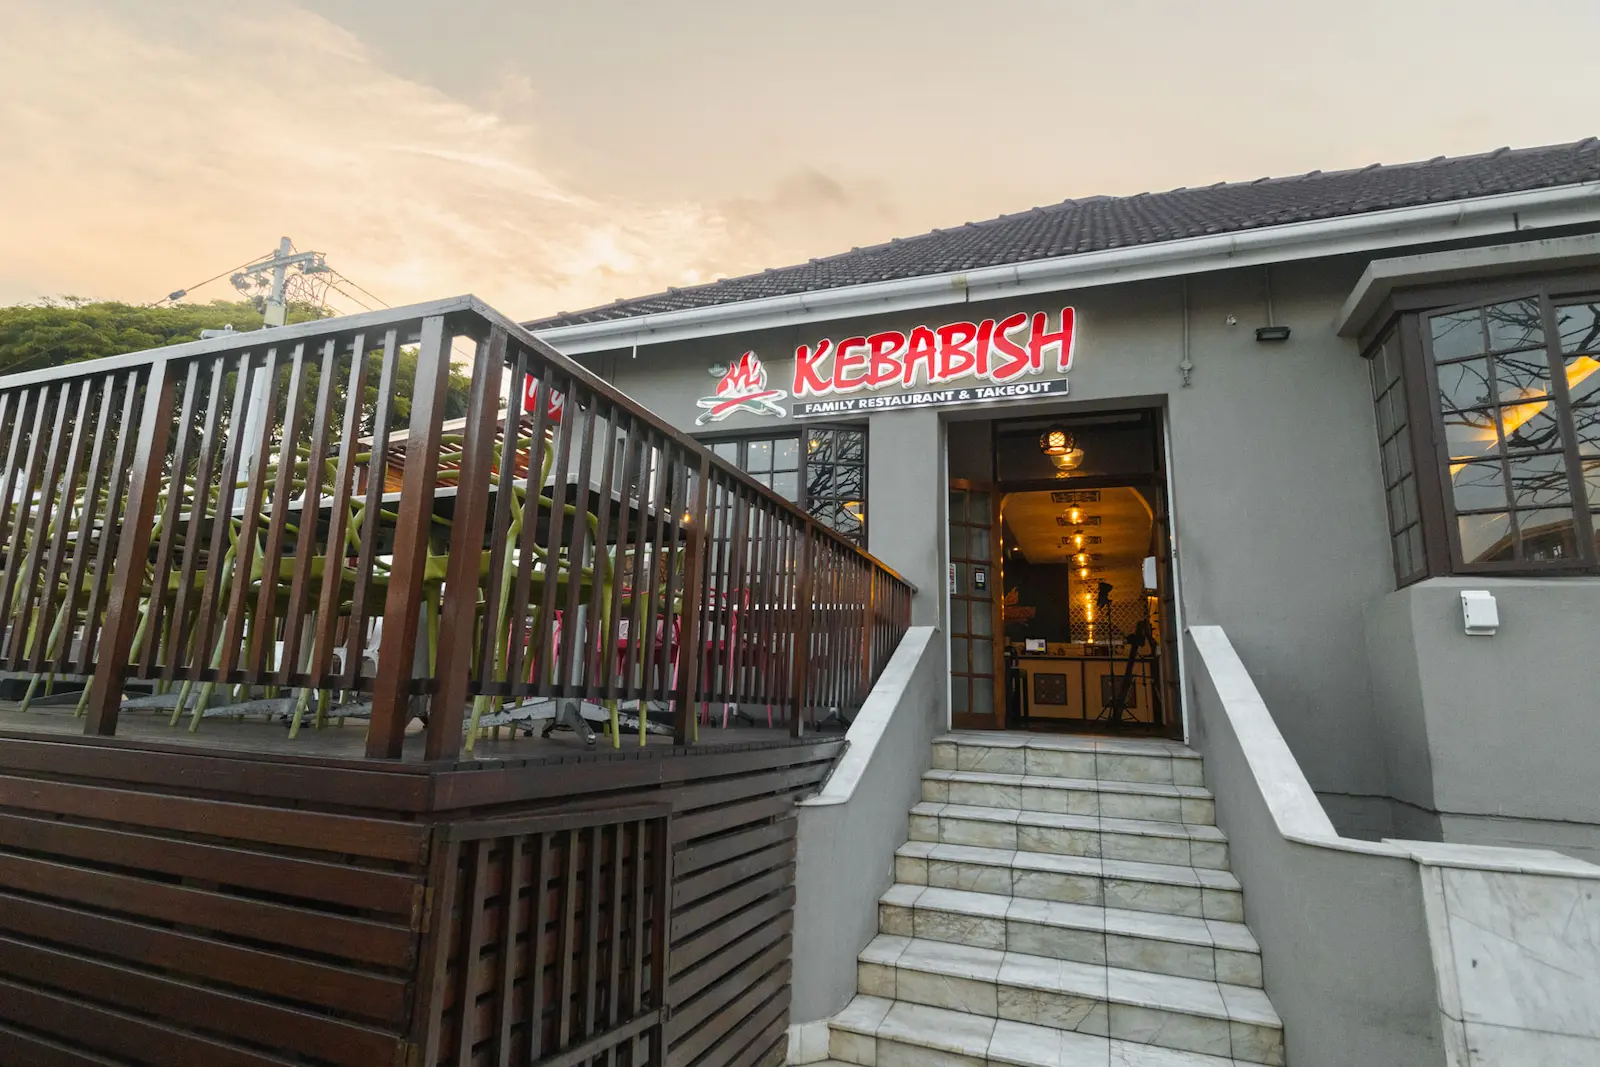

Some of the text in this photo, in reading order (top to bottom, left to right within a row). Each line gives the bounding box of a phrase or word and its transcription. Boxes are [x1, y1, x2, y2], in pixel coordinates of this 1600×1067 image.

[793, 307, 1074, 396] KEBABISH
[805, 382, 1051, 413] FAMILY RESTAURANT & TAKEOUT
